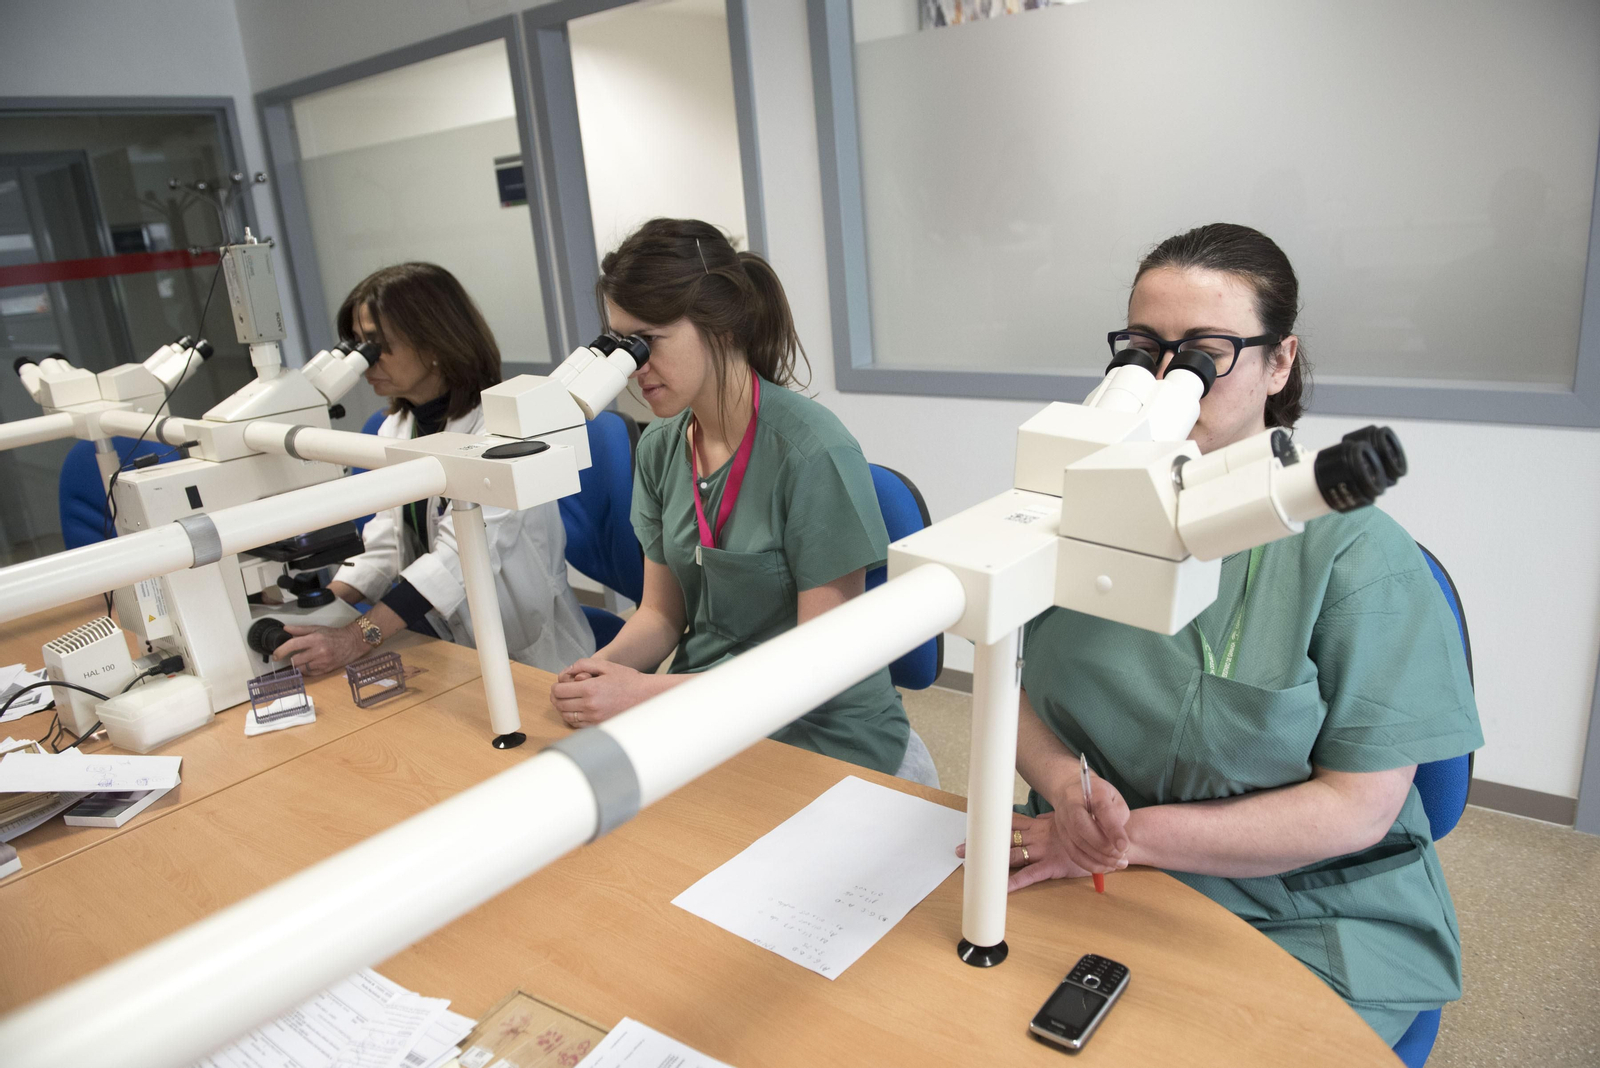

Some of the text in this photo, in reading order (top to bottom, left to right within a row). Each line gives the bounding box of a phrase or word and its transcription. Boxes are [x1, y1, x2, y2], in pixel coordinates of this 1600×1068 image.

[275, 311, 283, 333] SONY
[83, 663, 116, 679] HAL 100
